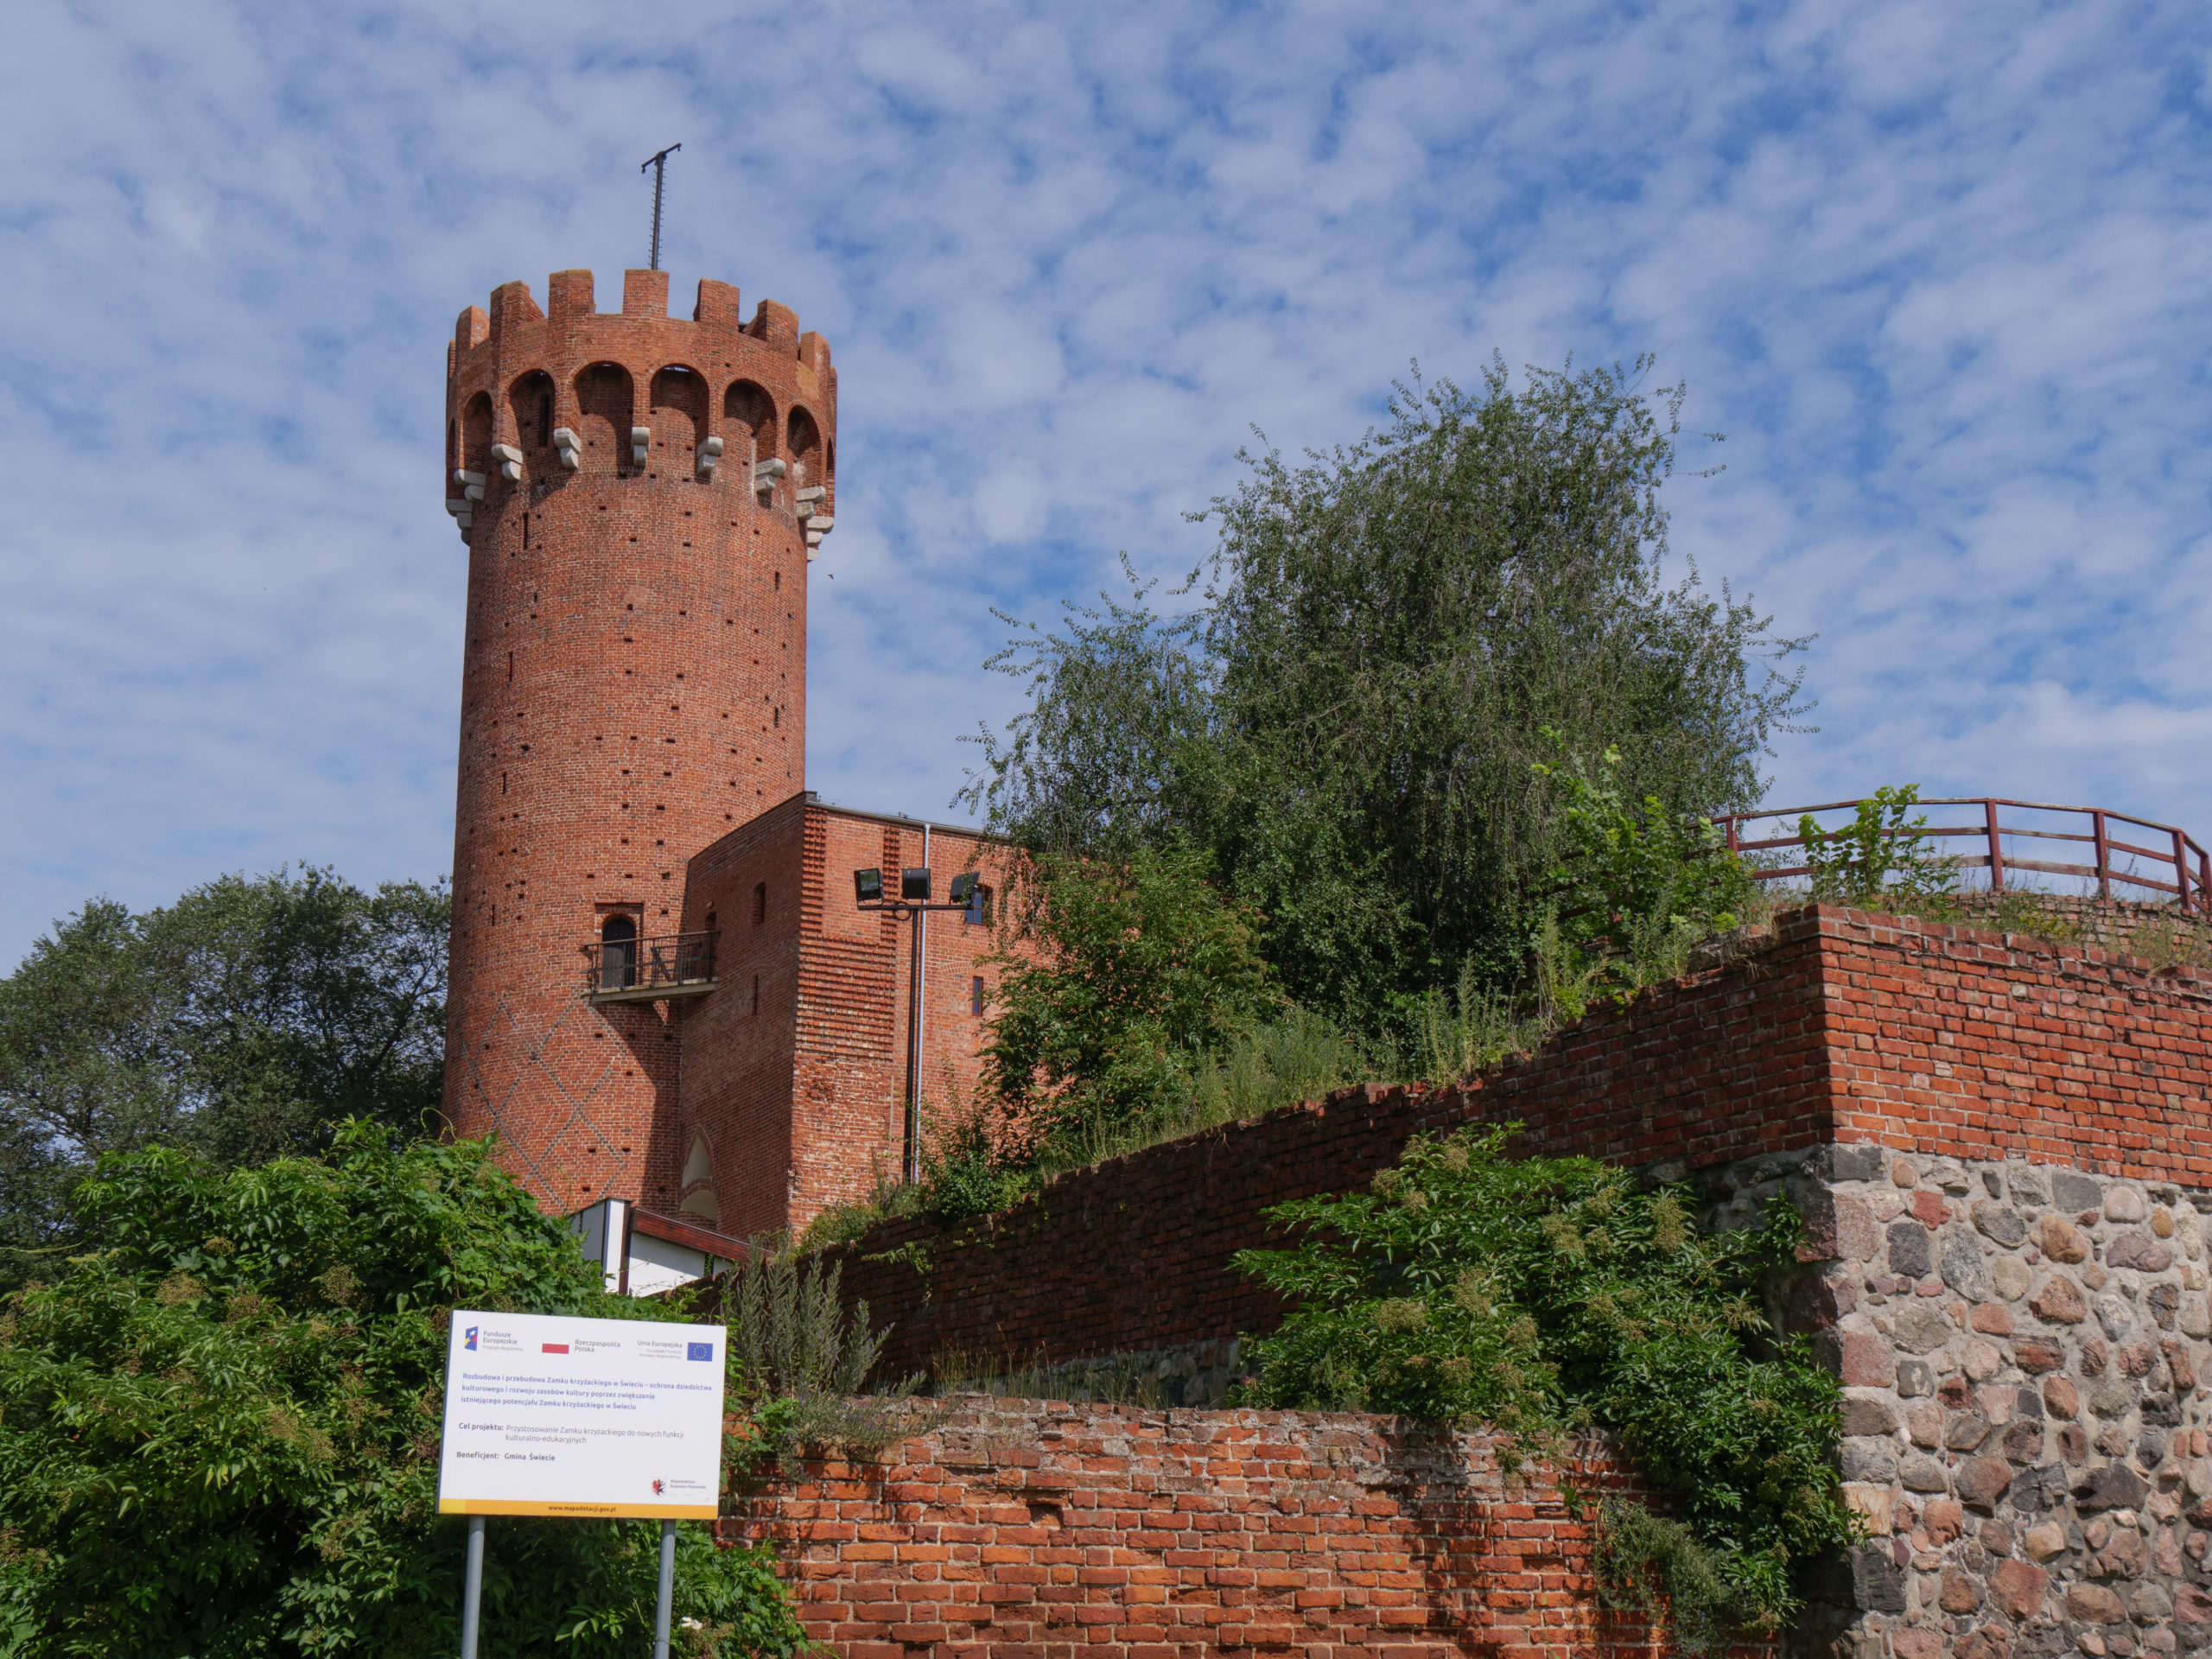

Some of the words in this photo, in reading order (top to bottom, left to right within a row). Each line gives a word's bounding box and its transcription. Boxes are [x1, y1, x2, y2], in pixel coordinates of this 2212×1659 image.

[483, 1330, 512, 1338] Fundusze
[482, 1338, 518, 1346] Europejskie
[575, 1339, 620, 1350] Rzeczpospolita
[652, 1341, 683, 1349] Europejska
[462, 1372, 500, 1381] Rozbudowa
[505, 1375, 545, 1384] przebudowa
[570, 1378, 612, 1387] krzyżackiego
[620, 1379, 644, 1388] Świeciu
[461, 1384, 504, 1394] kulturowego
[461, 1396, 501, 1405] istniejącego
[502, 1398, 538, 1407] potencjału
[563, 1401, 604, 1409] krzyżackiego
[613, 1402, 637, 1410] Świeciu
[584, 1427, 626, 1437] krzyżackiego
[637, 1430, 662, 1439] nowych
[663, 1431, 684, 1439] funkcji
[505, 1433, 587, 1445] kulturalno-edukacyjnych
[456, 1451, 500, 1460] Beneficjent:
[529, 1452, 556, 1461] Świecie
